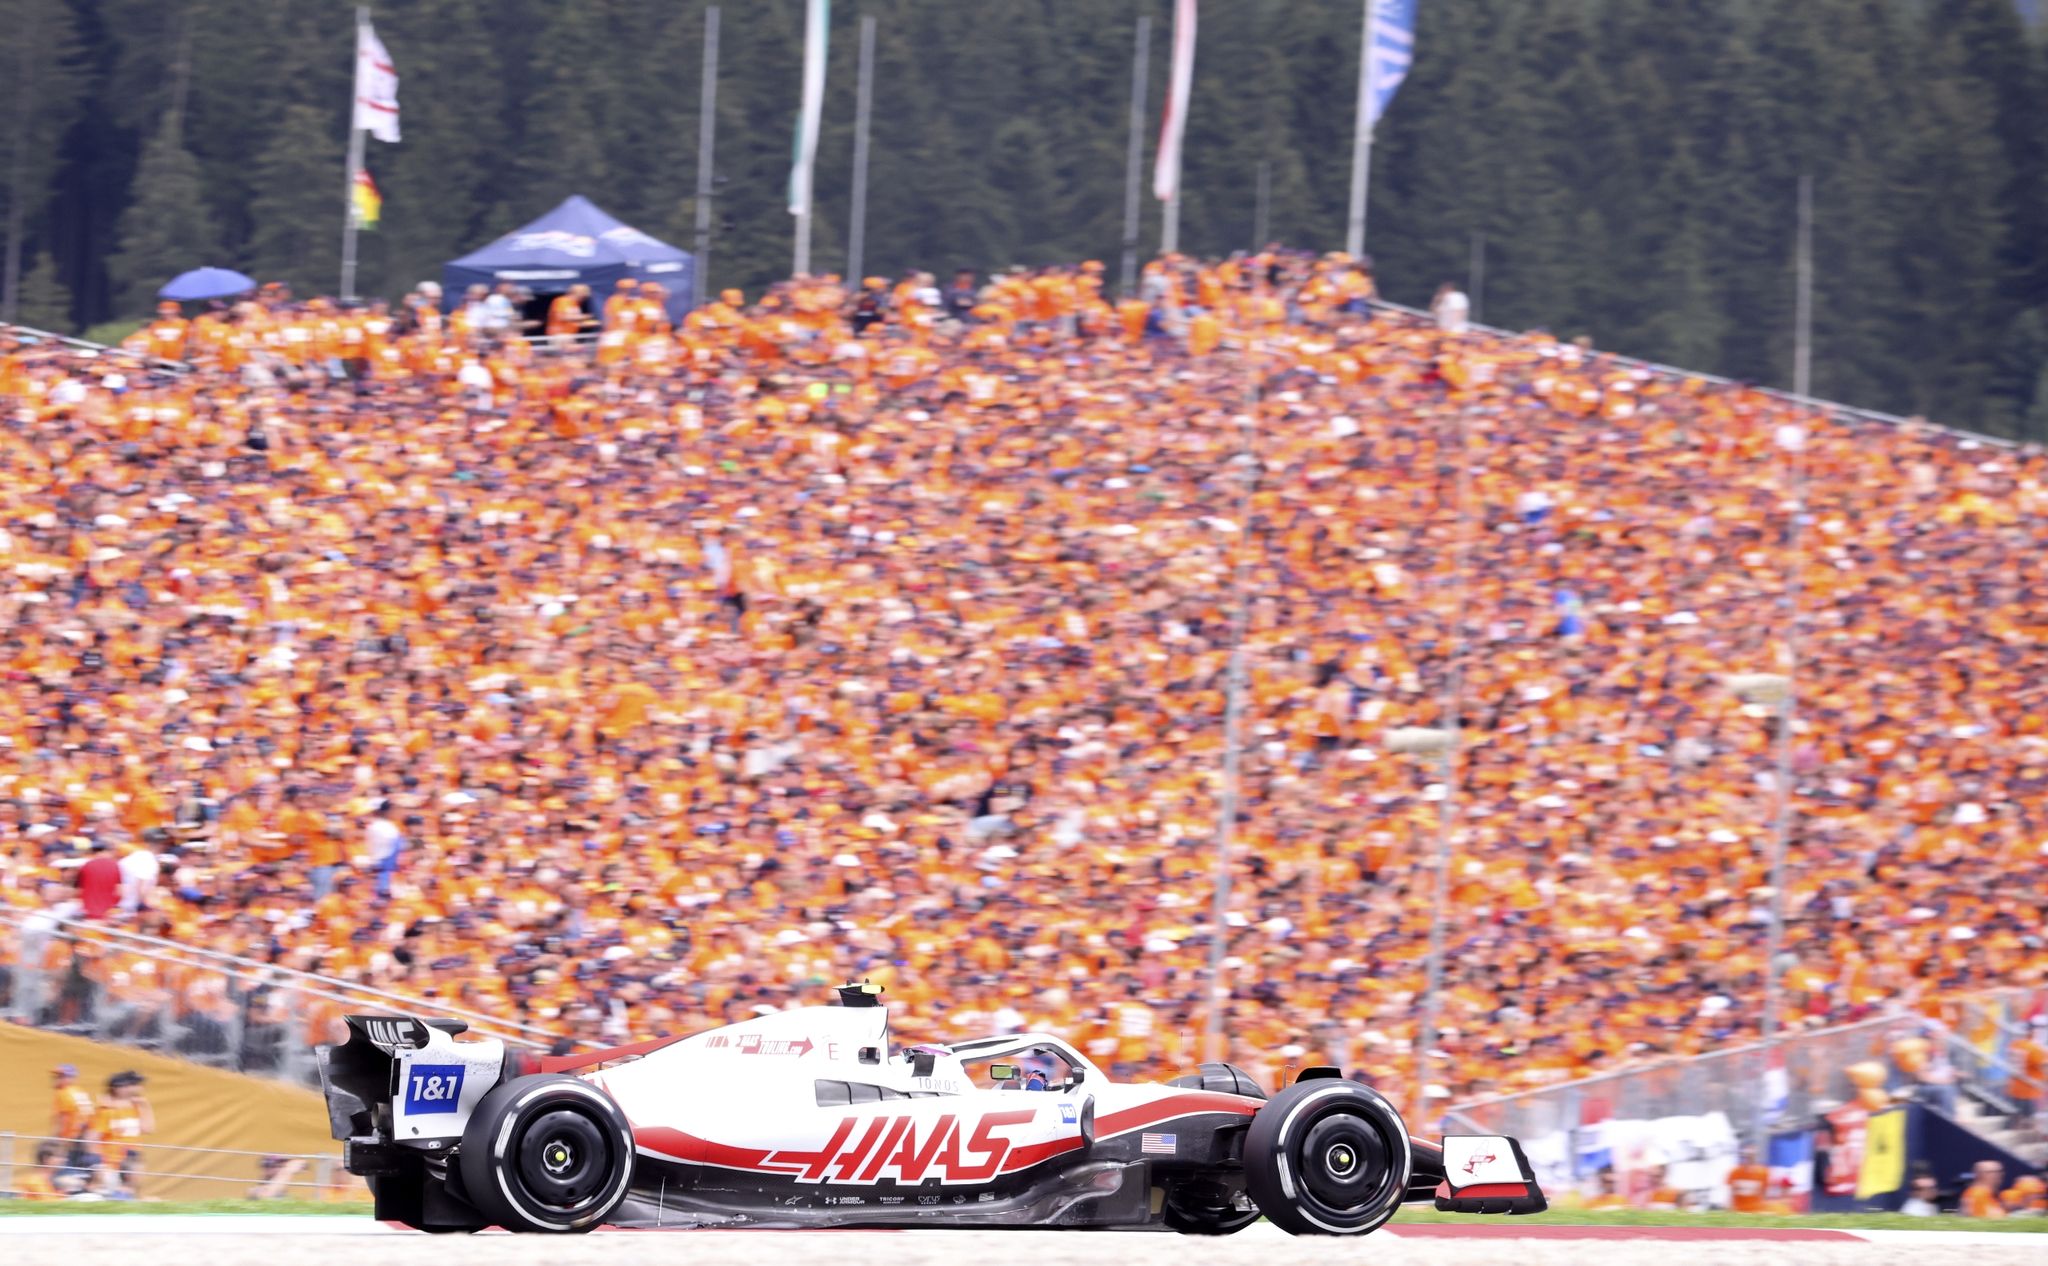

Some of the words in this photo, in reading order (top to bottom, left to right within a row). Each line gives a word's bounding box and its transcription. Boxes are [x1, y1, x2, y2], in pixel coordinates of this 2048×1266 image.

[412, 1075, 458, 1102] 1&1
[919, 1077, 959, 1092] IONOS
[769, 1109, 1037, 1181] HAAS
